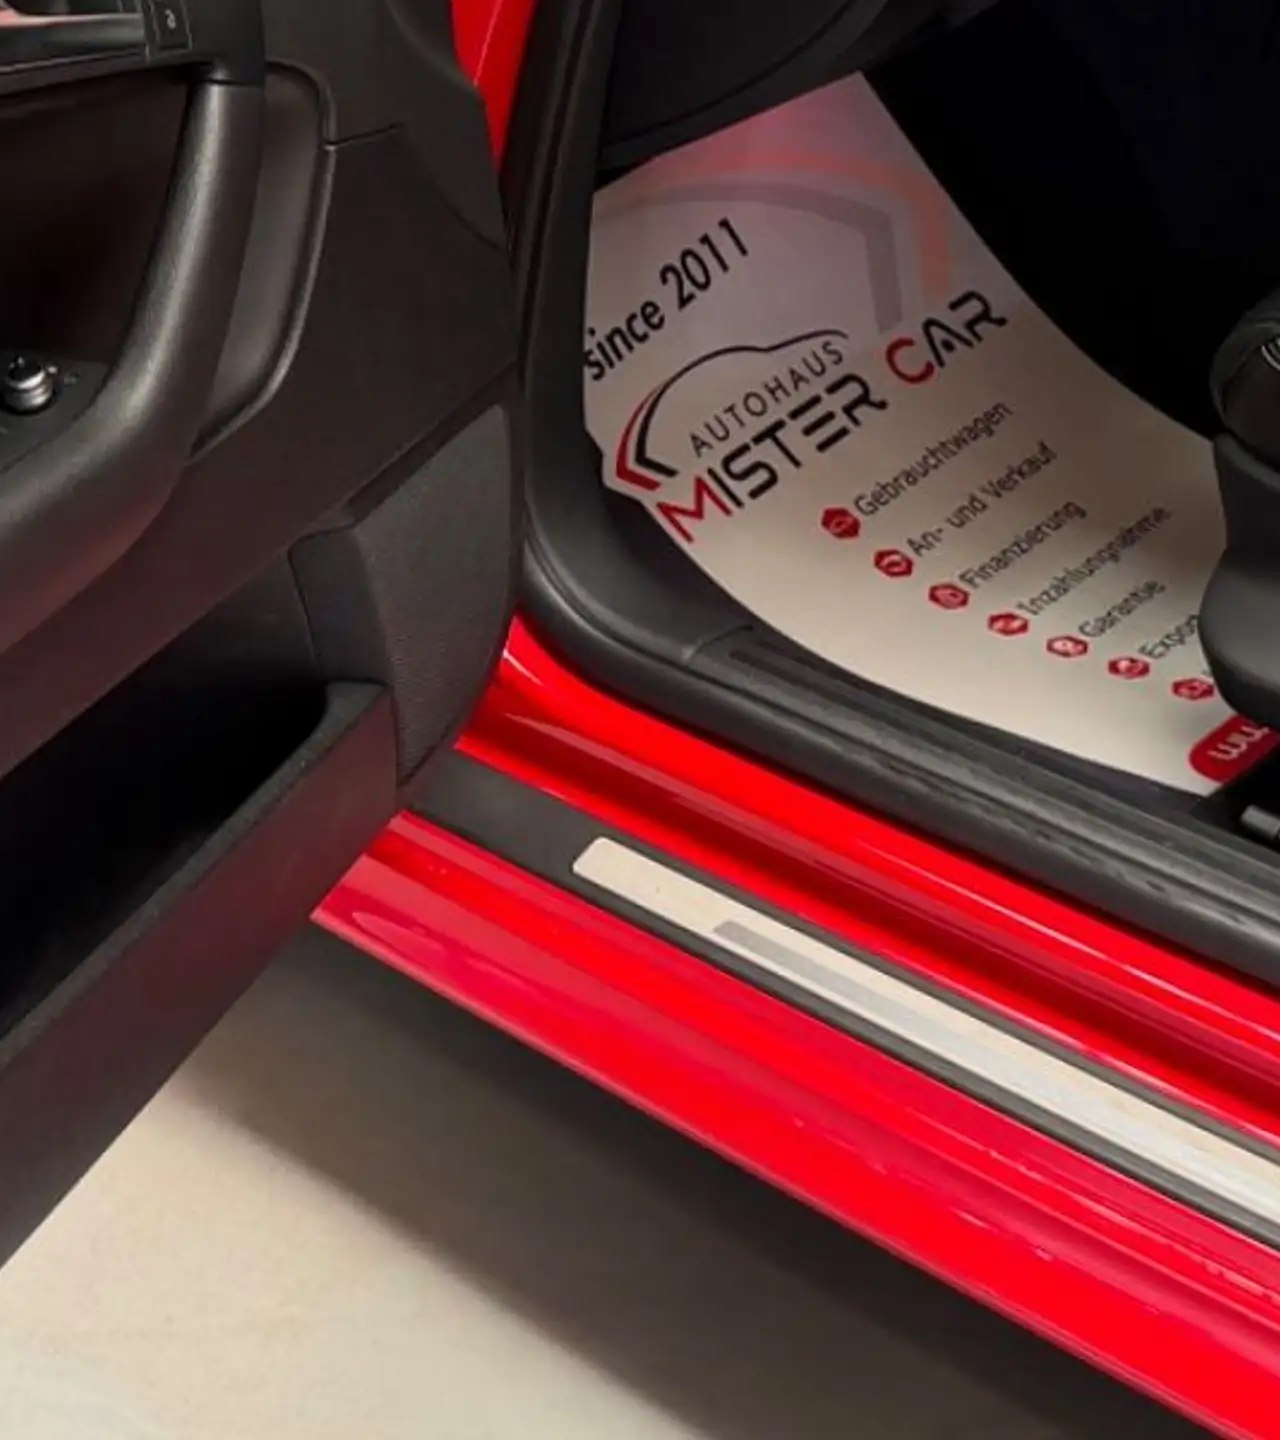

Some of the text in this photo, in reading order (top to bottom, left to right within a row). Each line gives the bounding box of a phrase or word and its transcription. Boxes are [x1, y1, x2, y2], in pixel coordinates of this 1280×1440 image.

[583, 217, 749, 382] since 2011
[656, 290, 1008, 544] MISTER CAR
[688, 340, 844, 458] AUTOHAUS
[853, 401, 1013, 517] Gebrauchtwagen
[906, 439, 1058, 558] An- und Verkauf
[958, 500, 1087, 590] Finanzierung
